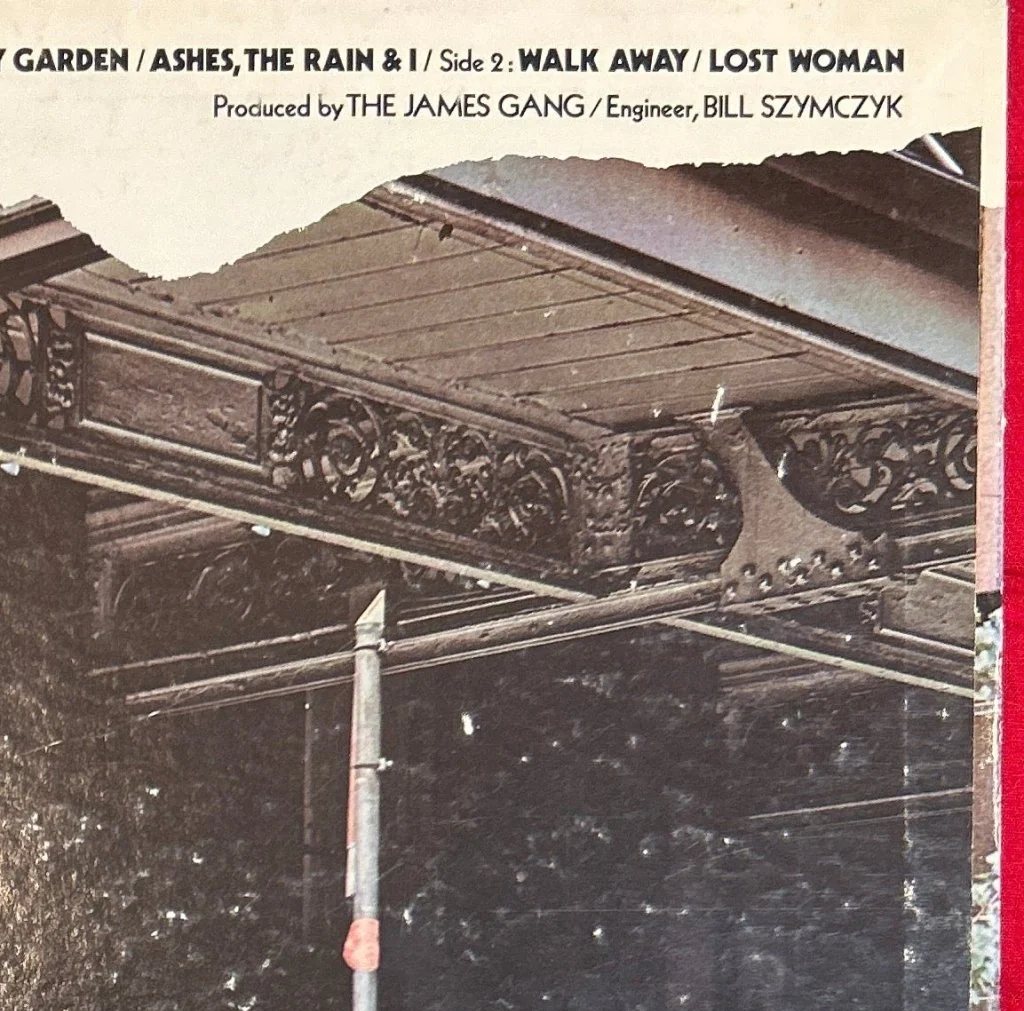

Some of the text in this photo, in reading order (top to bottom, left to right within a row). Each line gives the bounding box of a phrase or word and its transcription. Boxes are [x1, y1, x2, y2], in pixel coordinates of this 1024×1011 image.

[13, 48, 128, 73] GARDEN
[150, 48, 240, 77] ASHES,
[243, 48, 294, 73] THE
[304, 48, 373, 72] RAIN
[382, 48, 403, 72] &
[410, 48, 417, 72] I
[440, 49, 484, 73] Side
[518, 48, 598, 73] WALK
[609, 49, 688, 73] AWAY
[710, 49, 778, 73] LOST
[789, 49, 904, 73] WOMAN
[214, 94, 310, 118] Produced
[319, 94, 344, 122] by
[347, 94, 396, 118] THE
[404, 94, 490, 118] JAMES
[498, 94, 584, 118] GANG
[607, 95, 699, 123] Engineer,
[704, 95, 753, 118] BILL
[761, 95, 903, 119] SZYMCZYK
